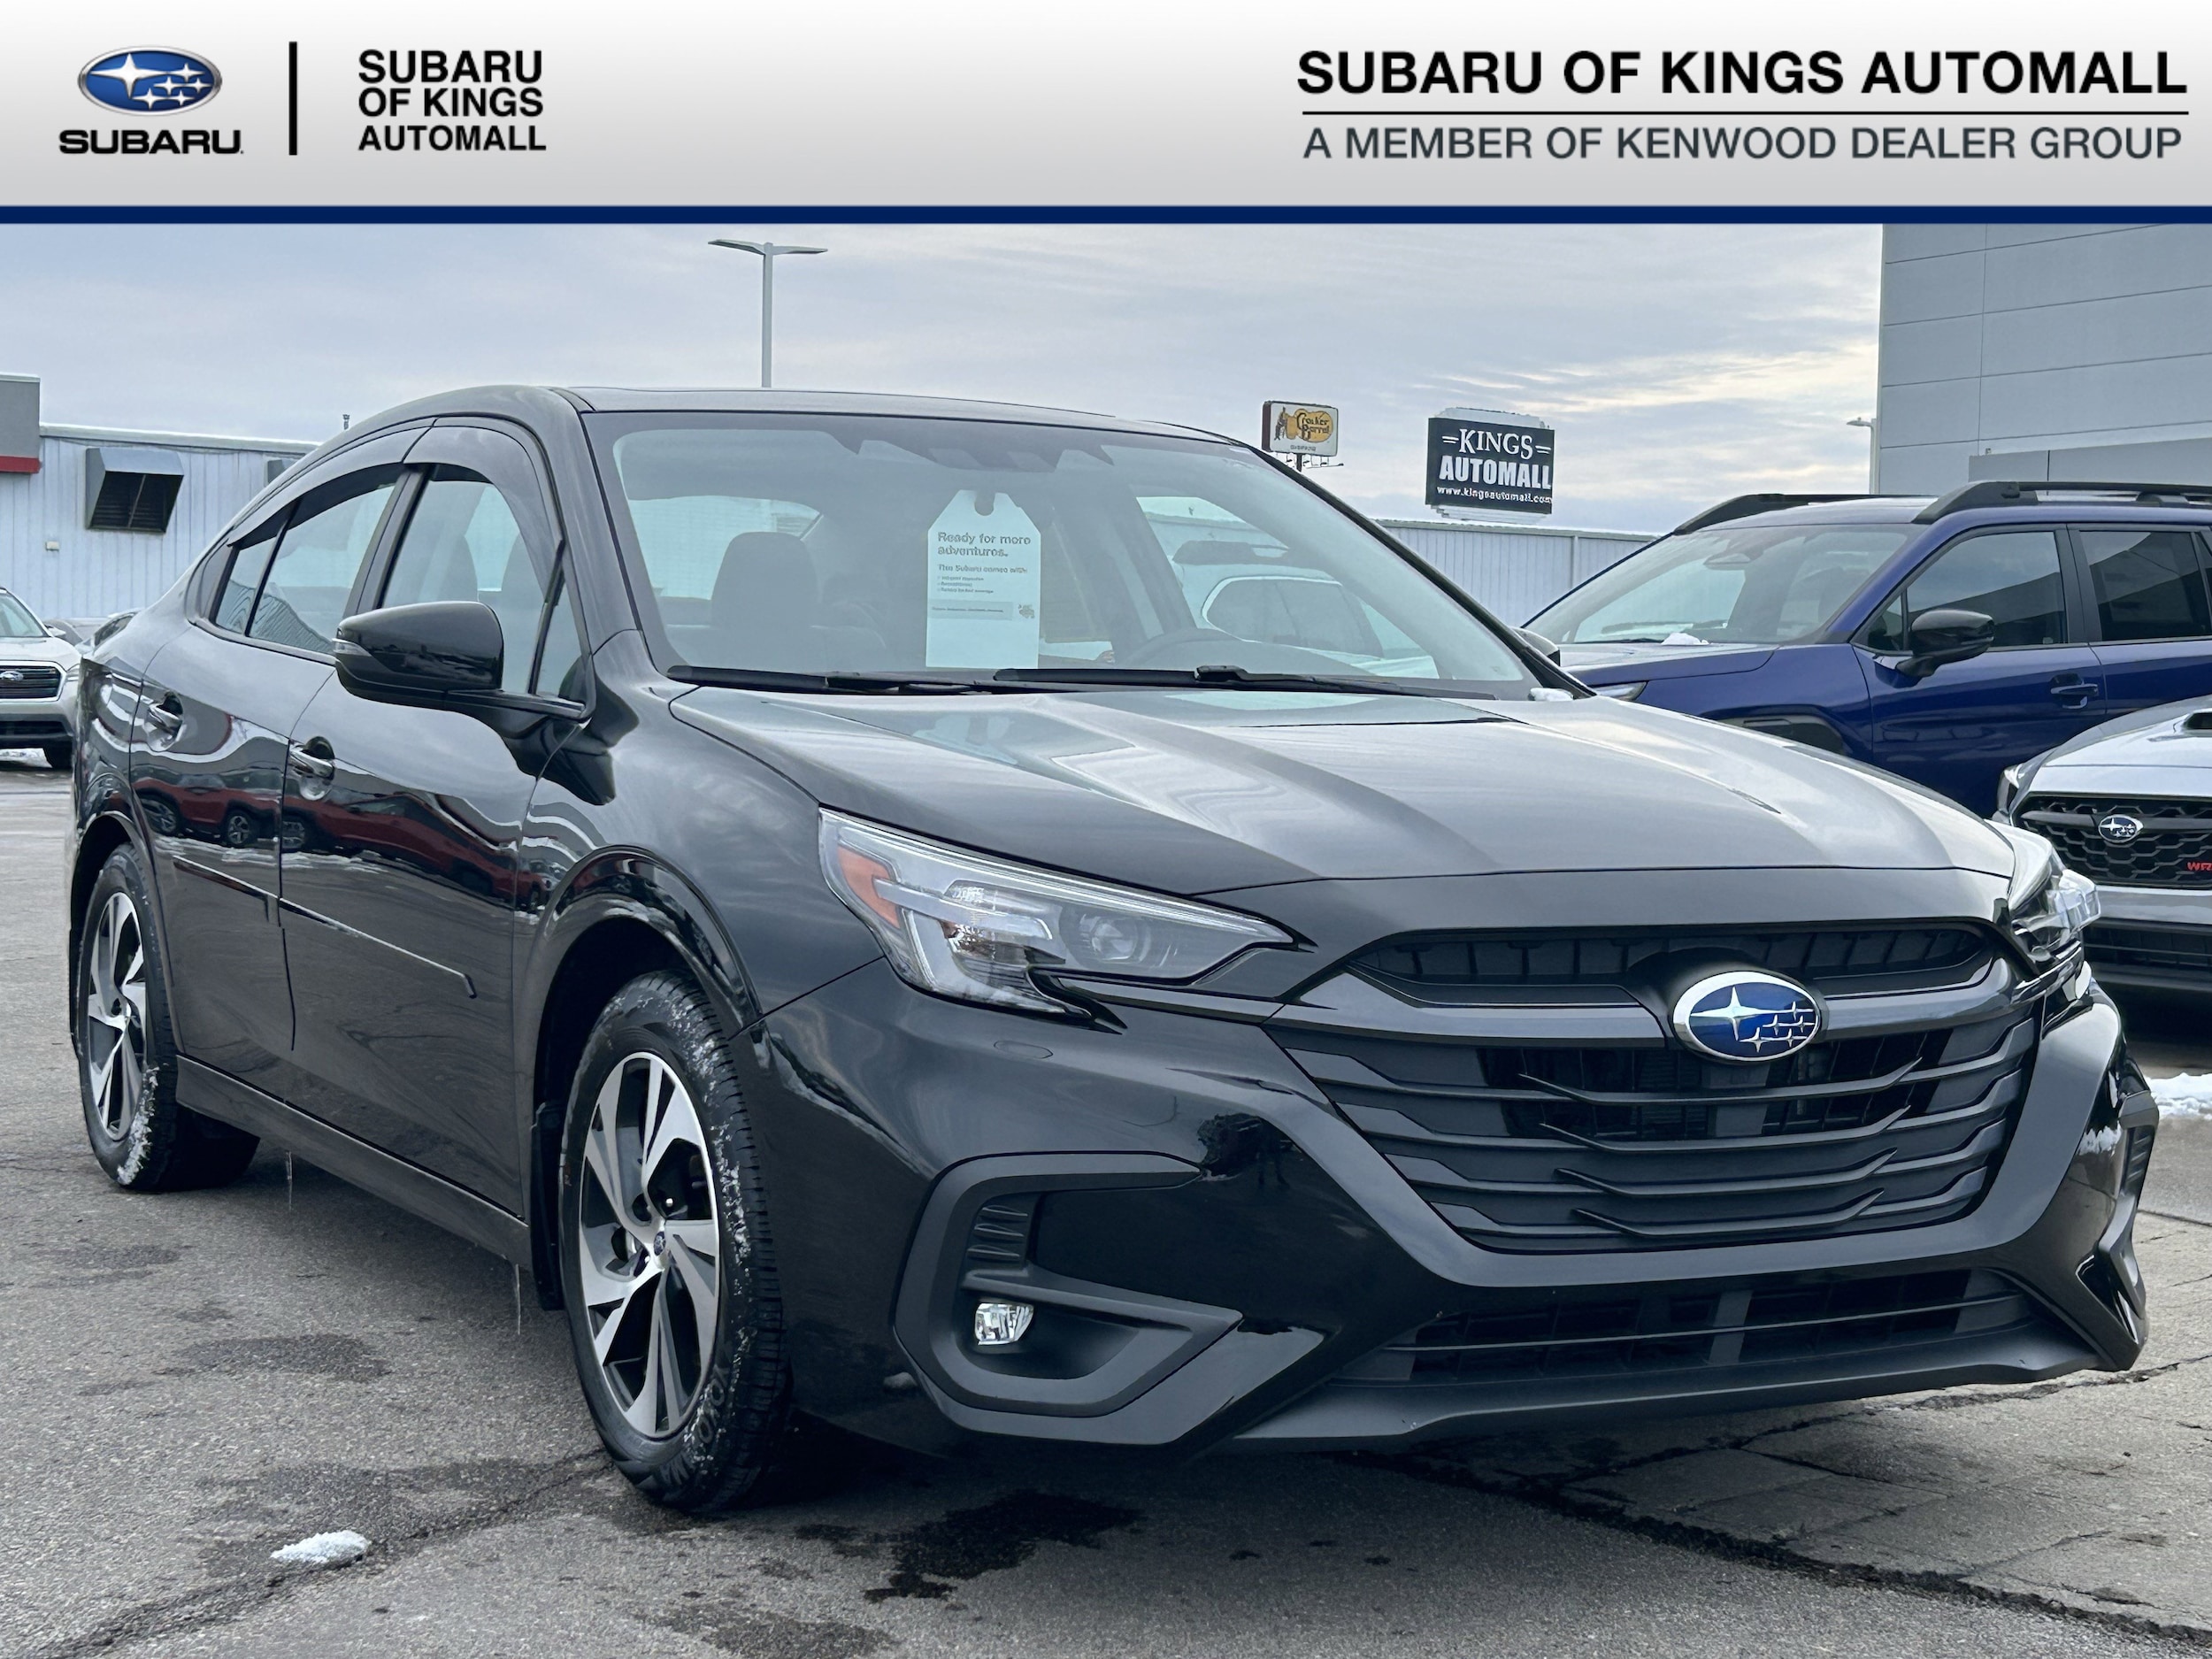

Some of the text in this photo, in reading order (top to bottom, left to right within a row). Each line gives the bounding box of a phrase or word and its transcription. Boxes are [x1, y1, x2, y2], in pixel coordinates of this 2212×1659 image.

[1459, 428, 1533, 460] KINGS
[1439, 455, 1552, 489] AUTOMALL
[1436, 486, 1553, 504] www.kingsautomall.com
[938, 532, 1032, 545] Ready for more
[938, 545, 1009, 557] adventures.
[2187, 862, 2212, 872] WR
